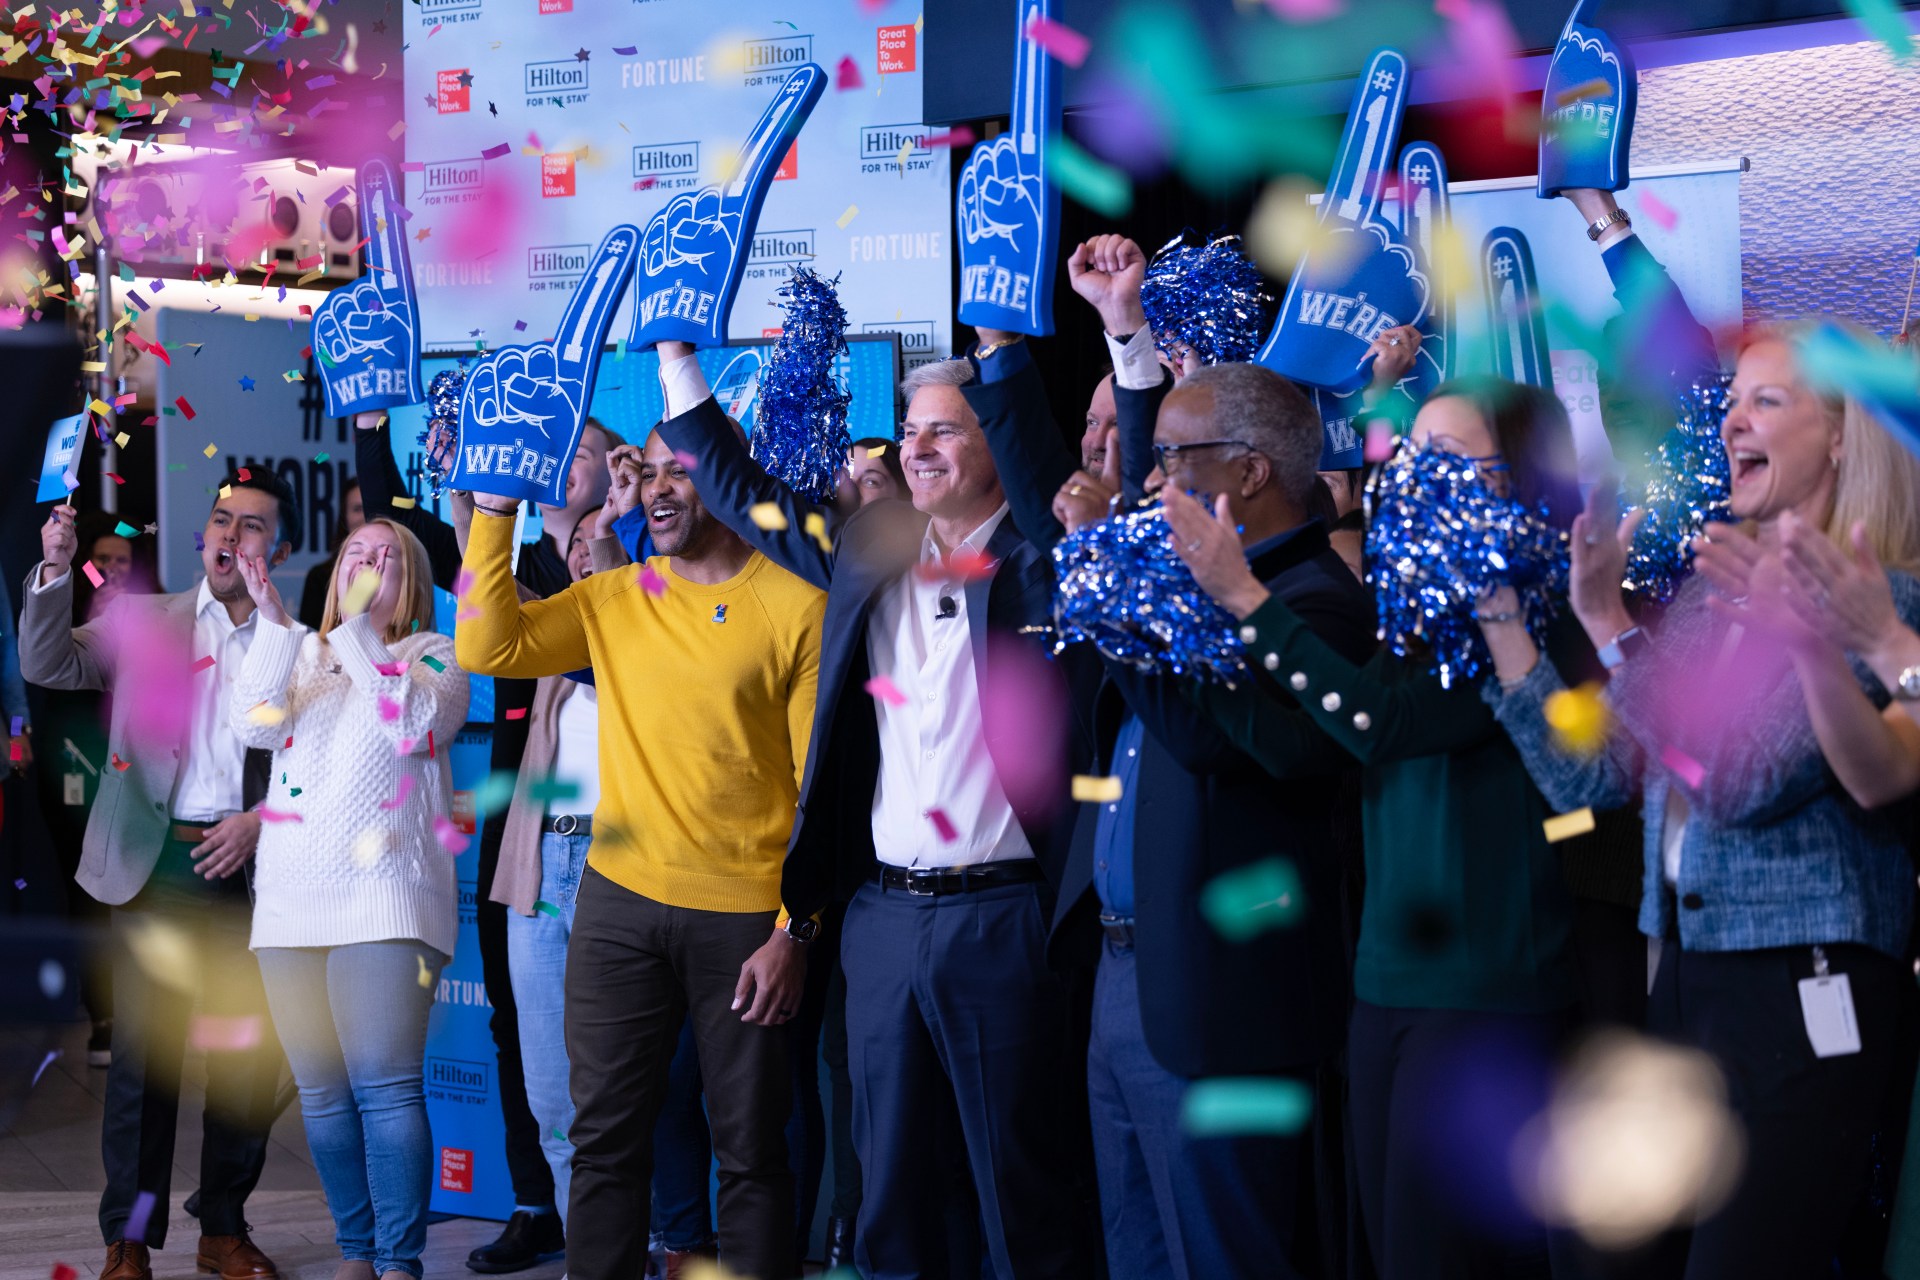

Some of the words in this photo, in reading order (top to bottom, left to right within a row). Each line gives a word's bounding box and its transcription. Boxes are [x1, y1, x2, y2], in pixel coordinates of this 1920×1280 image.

[422, 16, 438, 26] FOR
[441, 14, 458, 24] THE
[460, 12, 480, 22] STAY
[879, 29, 906, 40] Great
[880, 40, 906, 50] Place
[750, 46, 806, 66] Hilton
[880, 50, 890, 60] To
[531, 68, 582, 87] Hilton
[622, 56, 705, 89] FORTUNE
[744, 78, 763, 87] FOR
[766, 74, 784, 85] THE
[440, 83, 462, 92] Place
[440, 93, 448, 102] To
[526, 98, 543, 107] FOR
[567, 94, 587, 104] STAY
[544, 156, 566, 166] Great
[639, 151, 692, 170] Hilton
[862, 164, 880, 173] FOR
[907, 161, 931, 170] STAY
[430, 167, 478, 186] Hilton
[544, 166, 566, 175] Place
[544, 176, 554, 186] To
[656, 180, 672, 190] THE
[676, 178, 697, 188] STAY
[425, 196, 440, 206] FOR
[444, 195, 460, 204] THE
[463, 194, 480, 202] STAY
[752, 238, 808, 258] Hilton
[851, 232, 941, 263] FORTUNE
[534, 253, 584, 271] Hilton
[415, 262, 492, 288] FORTUNE
[746, 270, 765, 279] FOR
[768, 268, 787, 278] THE
[530, 282, 546, 292] FOR
[549, 281, 565, 290] THE
[963, 255, 1030, 313] WE'RE
[640, 278, 716, 330] WE'RE
[1297, 290, 1400, 346] WE'RE
[332, 362, 406, 406] WE'RE
[465, 438, 558, 488] WE'RE
[432, 1063, 482, 1086] Hilton
[430, 1090, 444, 1100] FOR
[448, 1092, 463, 1104] THE
[467, 1096, 486, 1106] STAY
[443, 1150, 466, 1162] Great
[444, 1159, 466, 1170] Place
[444, 1168, 452, 1178] To
